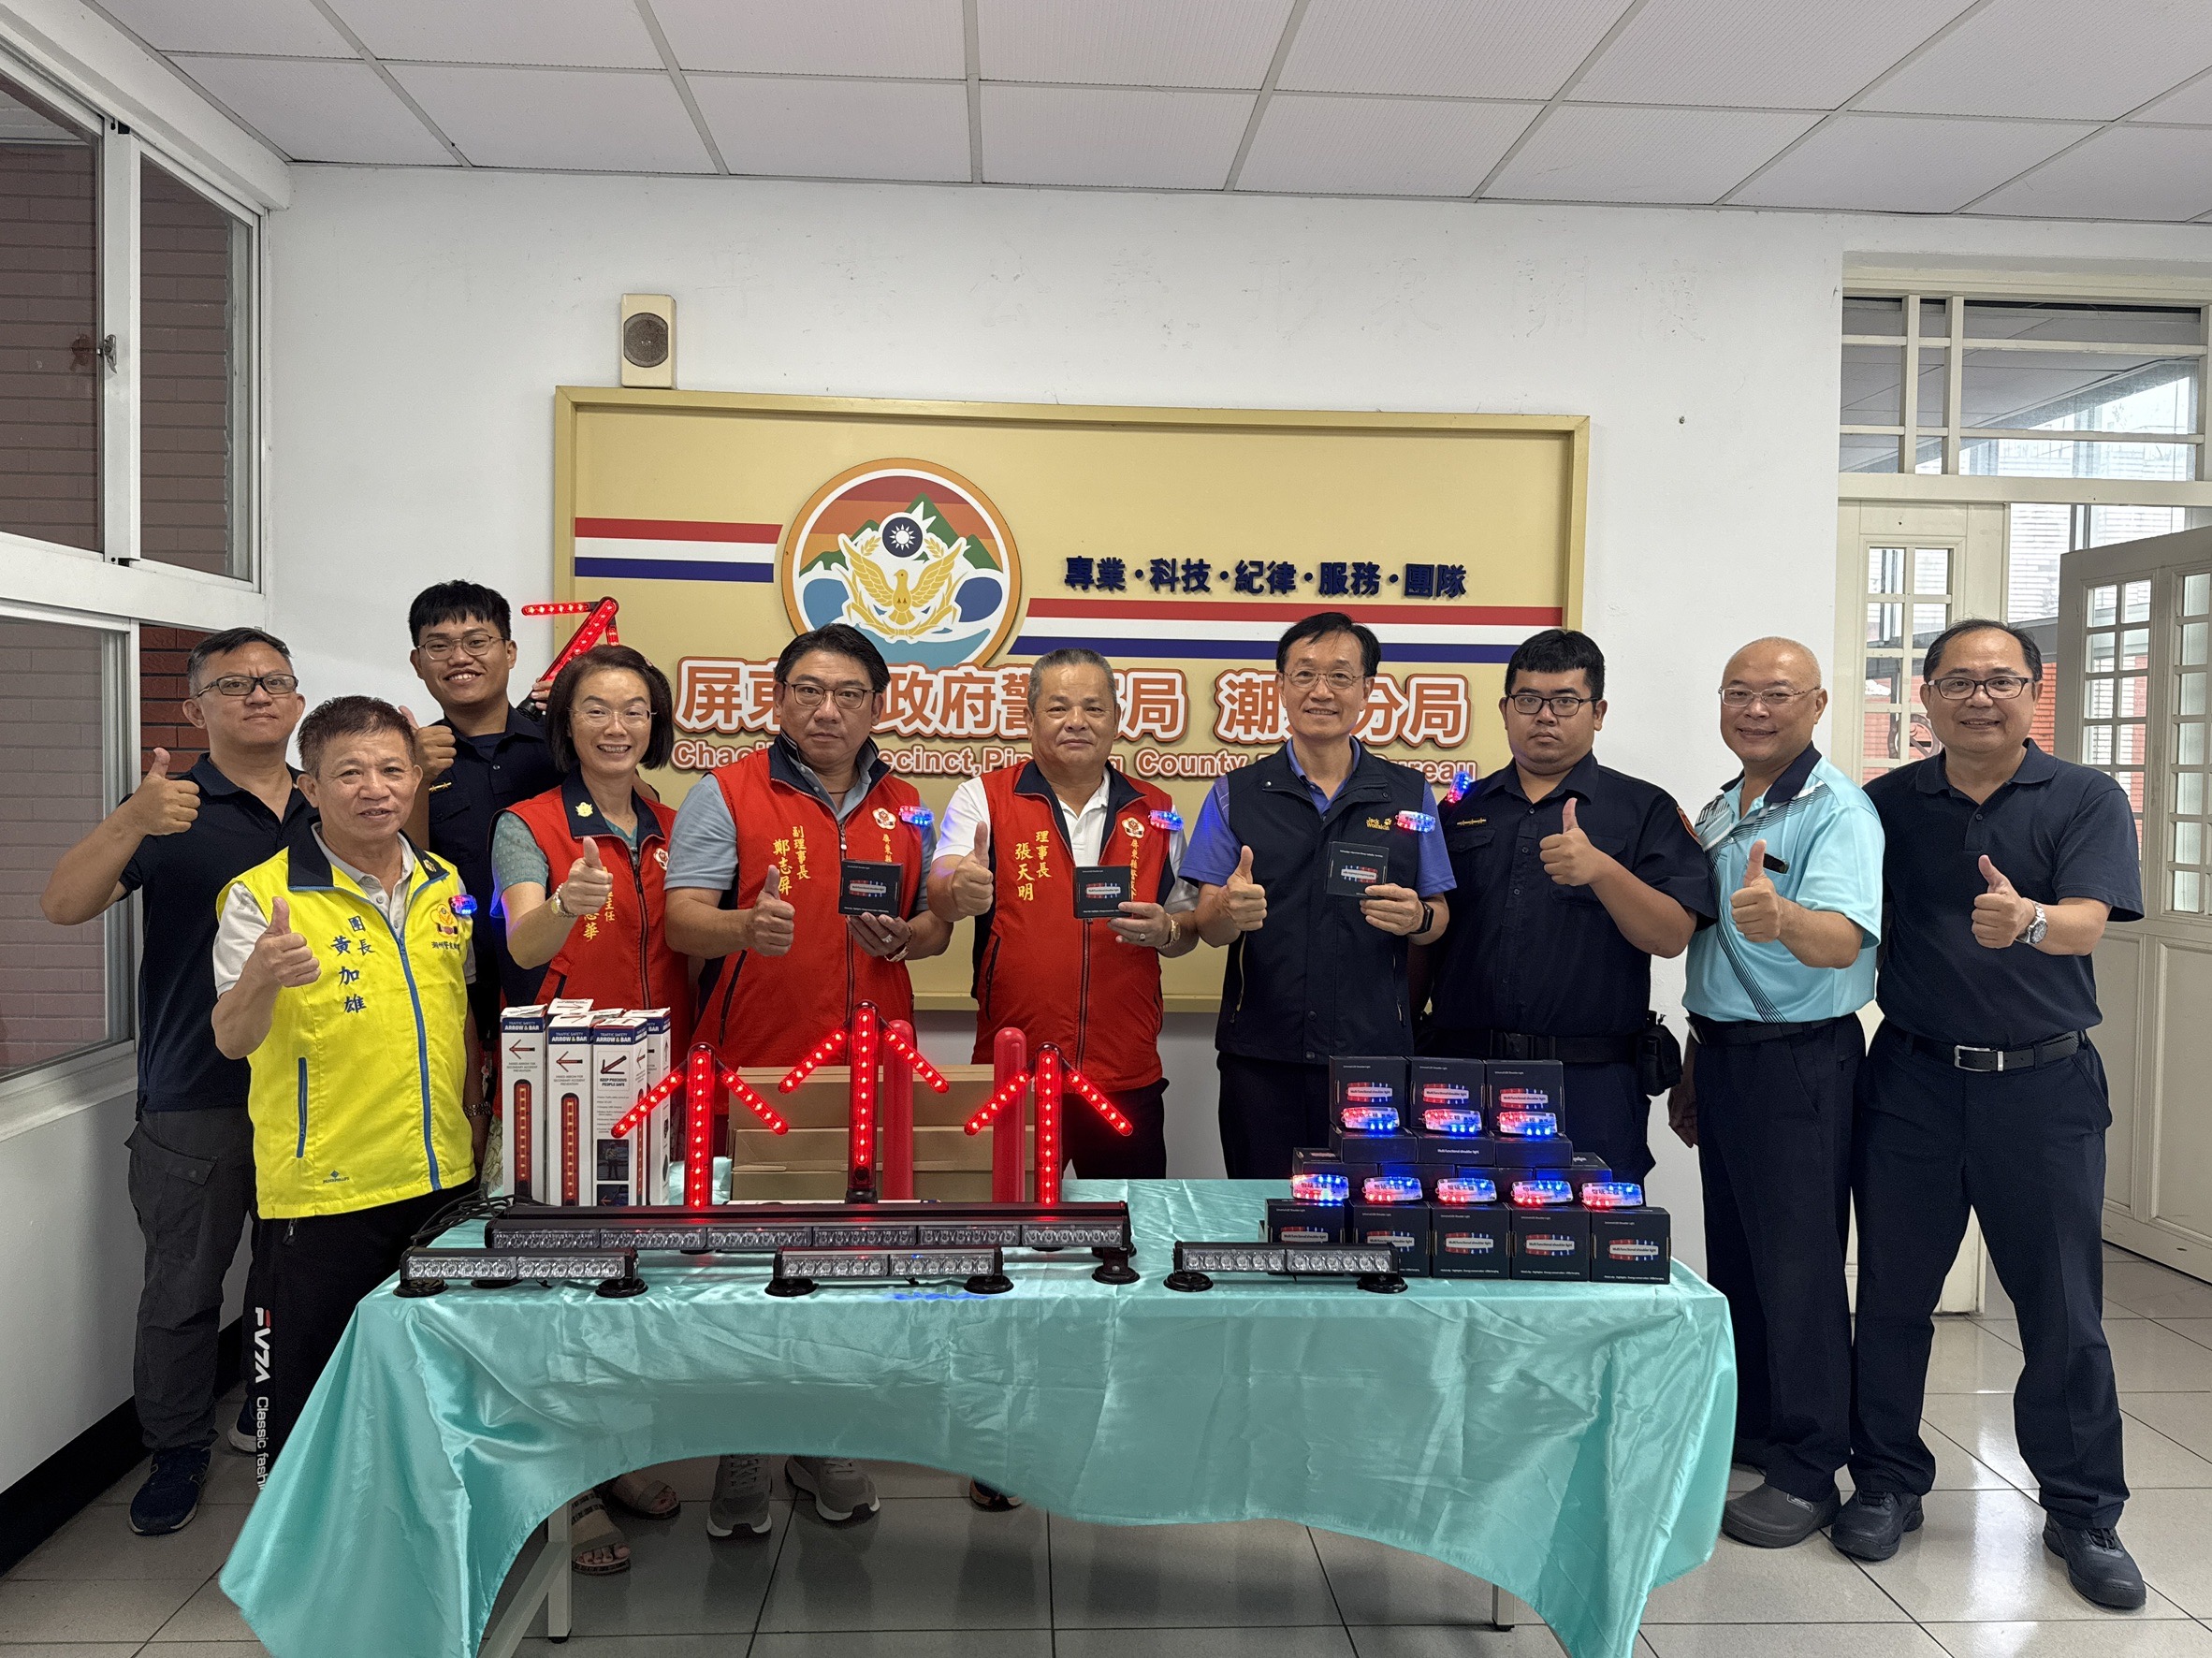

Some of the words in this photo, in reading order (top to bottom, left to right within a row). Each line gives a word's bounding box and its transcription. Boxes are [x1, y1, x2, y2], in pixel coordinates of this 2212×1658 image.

[792, 825, 810, 880] 副理事長
[1014, 842, 1036, 902] 張天明
[1035, 830, 1052, 879] 理事長
[348, 915, 375, 956] 團長
[330, 935, 367, 1013] 黃加雄
[256, 1396, 269, 1448] Classic
